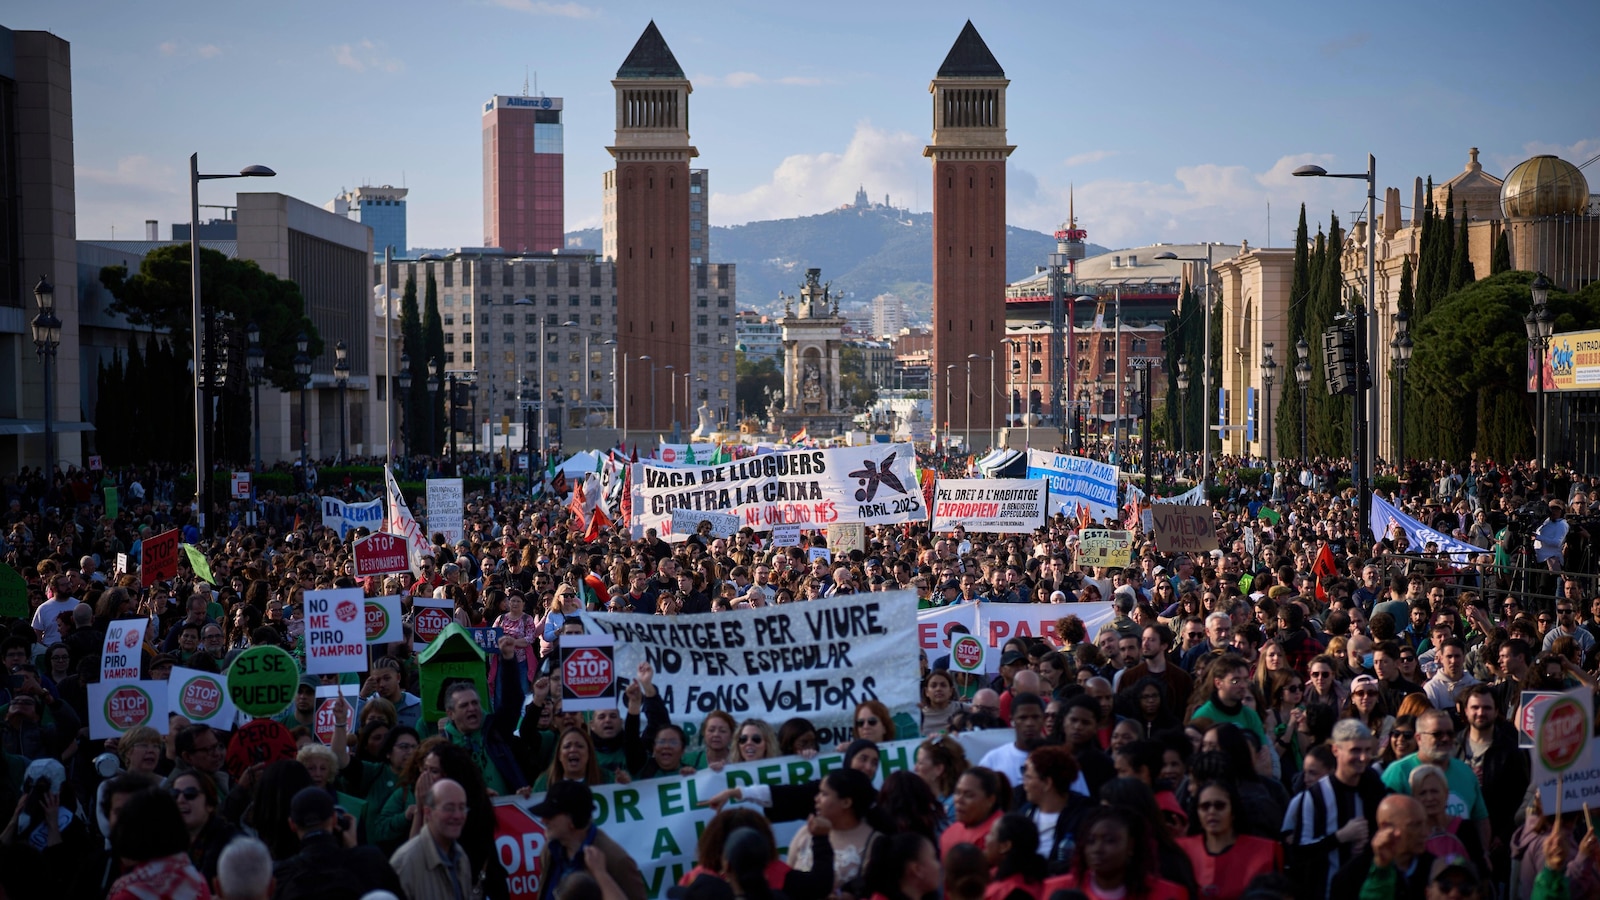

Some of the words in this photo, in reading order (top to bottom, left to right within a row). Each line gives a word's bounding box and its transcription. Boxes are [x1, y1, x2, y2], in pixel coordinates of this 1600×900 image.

[506, 98, 540, 107] Allianz
[702, 466, 726, 484] DE
[730, 451, 826, 482] LLOGUERS
[1054, 456, 1092, 474] ACABEM
[1092, 465, 1114, 481] AMB
[652, 488, 732, 516] CONTRA
[736, 486, 758, 506] LA
[763, 481, 823, 502] CAIXA
[937, 490, 952, 500] PEL
[954, 490, 977, 500] DRET
[978, 490, 984, 500] A
[986, 490, 1039, 500] L'HABITATGE
[326, 502, 341, 517] LA
[343, 506, 382, 522] LLUITA
[764, 504, 782, 524] UN
[814, 498, 838, 524] MÉS
[892, 496, 920, 514] 2025
[936, 502, 998, 518] EXPROPIEM
[674, 510, 684, 519] NO
[1000, 510, 1040, 518] ESPECULADORS
[1084, 532, 1109, 540] ESTA
[1170, 536, 1200, 548] MATA
[144, 538, 174, 564] STOP
[367, 536, 394, 552] STOP
[360, 555, 405, 572] DESNONAMENTS
[310, 599, 328, 613] NO
[337, 604, 355, 616] STOP
[310, 614, 330, 629] ME
[109, 628, 122, 640] NO
[310, 630, 344, 645] PIRO
[721, 620, 745, 648] ES
[754, 614, 794, 646] PER
[106, 641, 120, 654] ME
[310, 644, 362, 658] VAMPIRO
[958, 644, 980, 656] STOP
[104, 655, 127, 668] PIRO
[262, 654, 286, 672] SE
[645, 646, 682, 675] NO
[692, 648, 738, 676] PER
[744, 642, 852, 675] ESPECULAR
[104, 668, 138, 680] VAMPIRO
[567, 660, 610, 676] STOP
[568, 676, 608, 685] DESAHUCIOS
[187, 686, 219, 700] STOP
[232, 684, 292, 705] PUEDE
[685, 684, 749, 714] FONS
[111, 697, 144, 711] STOP
[185, 697, 216, 709] DESAHUCIOS
[238, 723, 280, 746] PERO
[246, 742, 272, 763] NO
[658, 778, 706, 817] EL
[1565, 789, 1580, 800] AL
[652, 828, 682, 860] A
